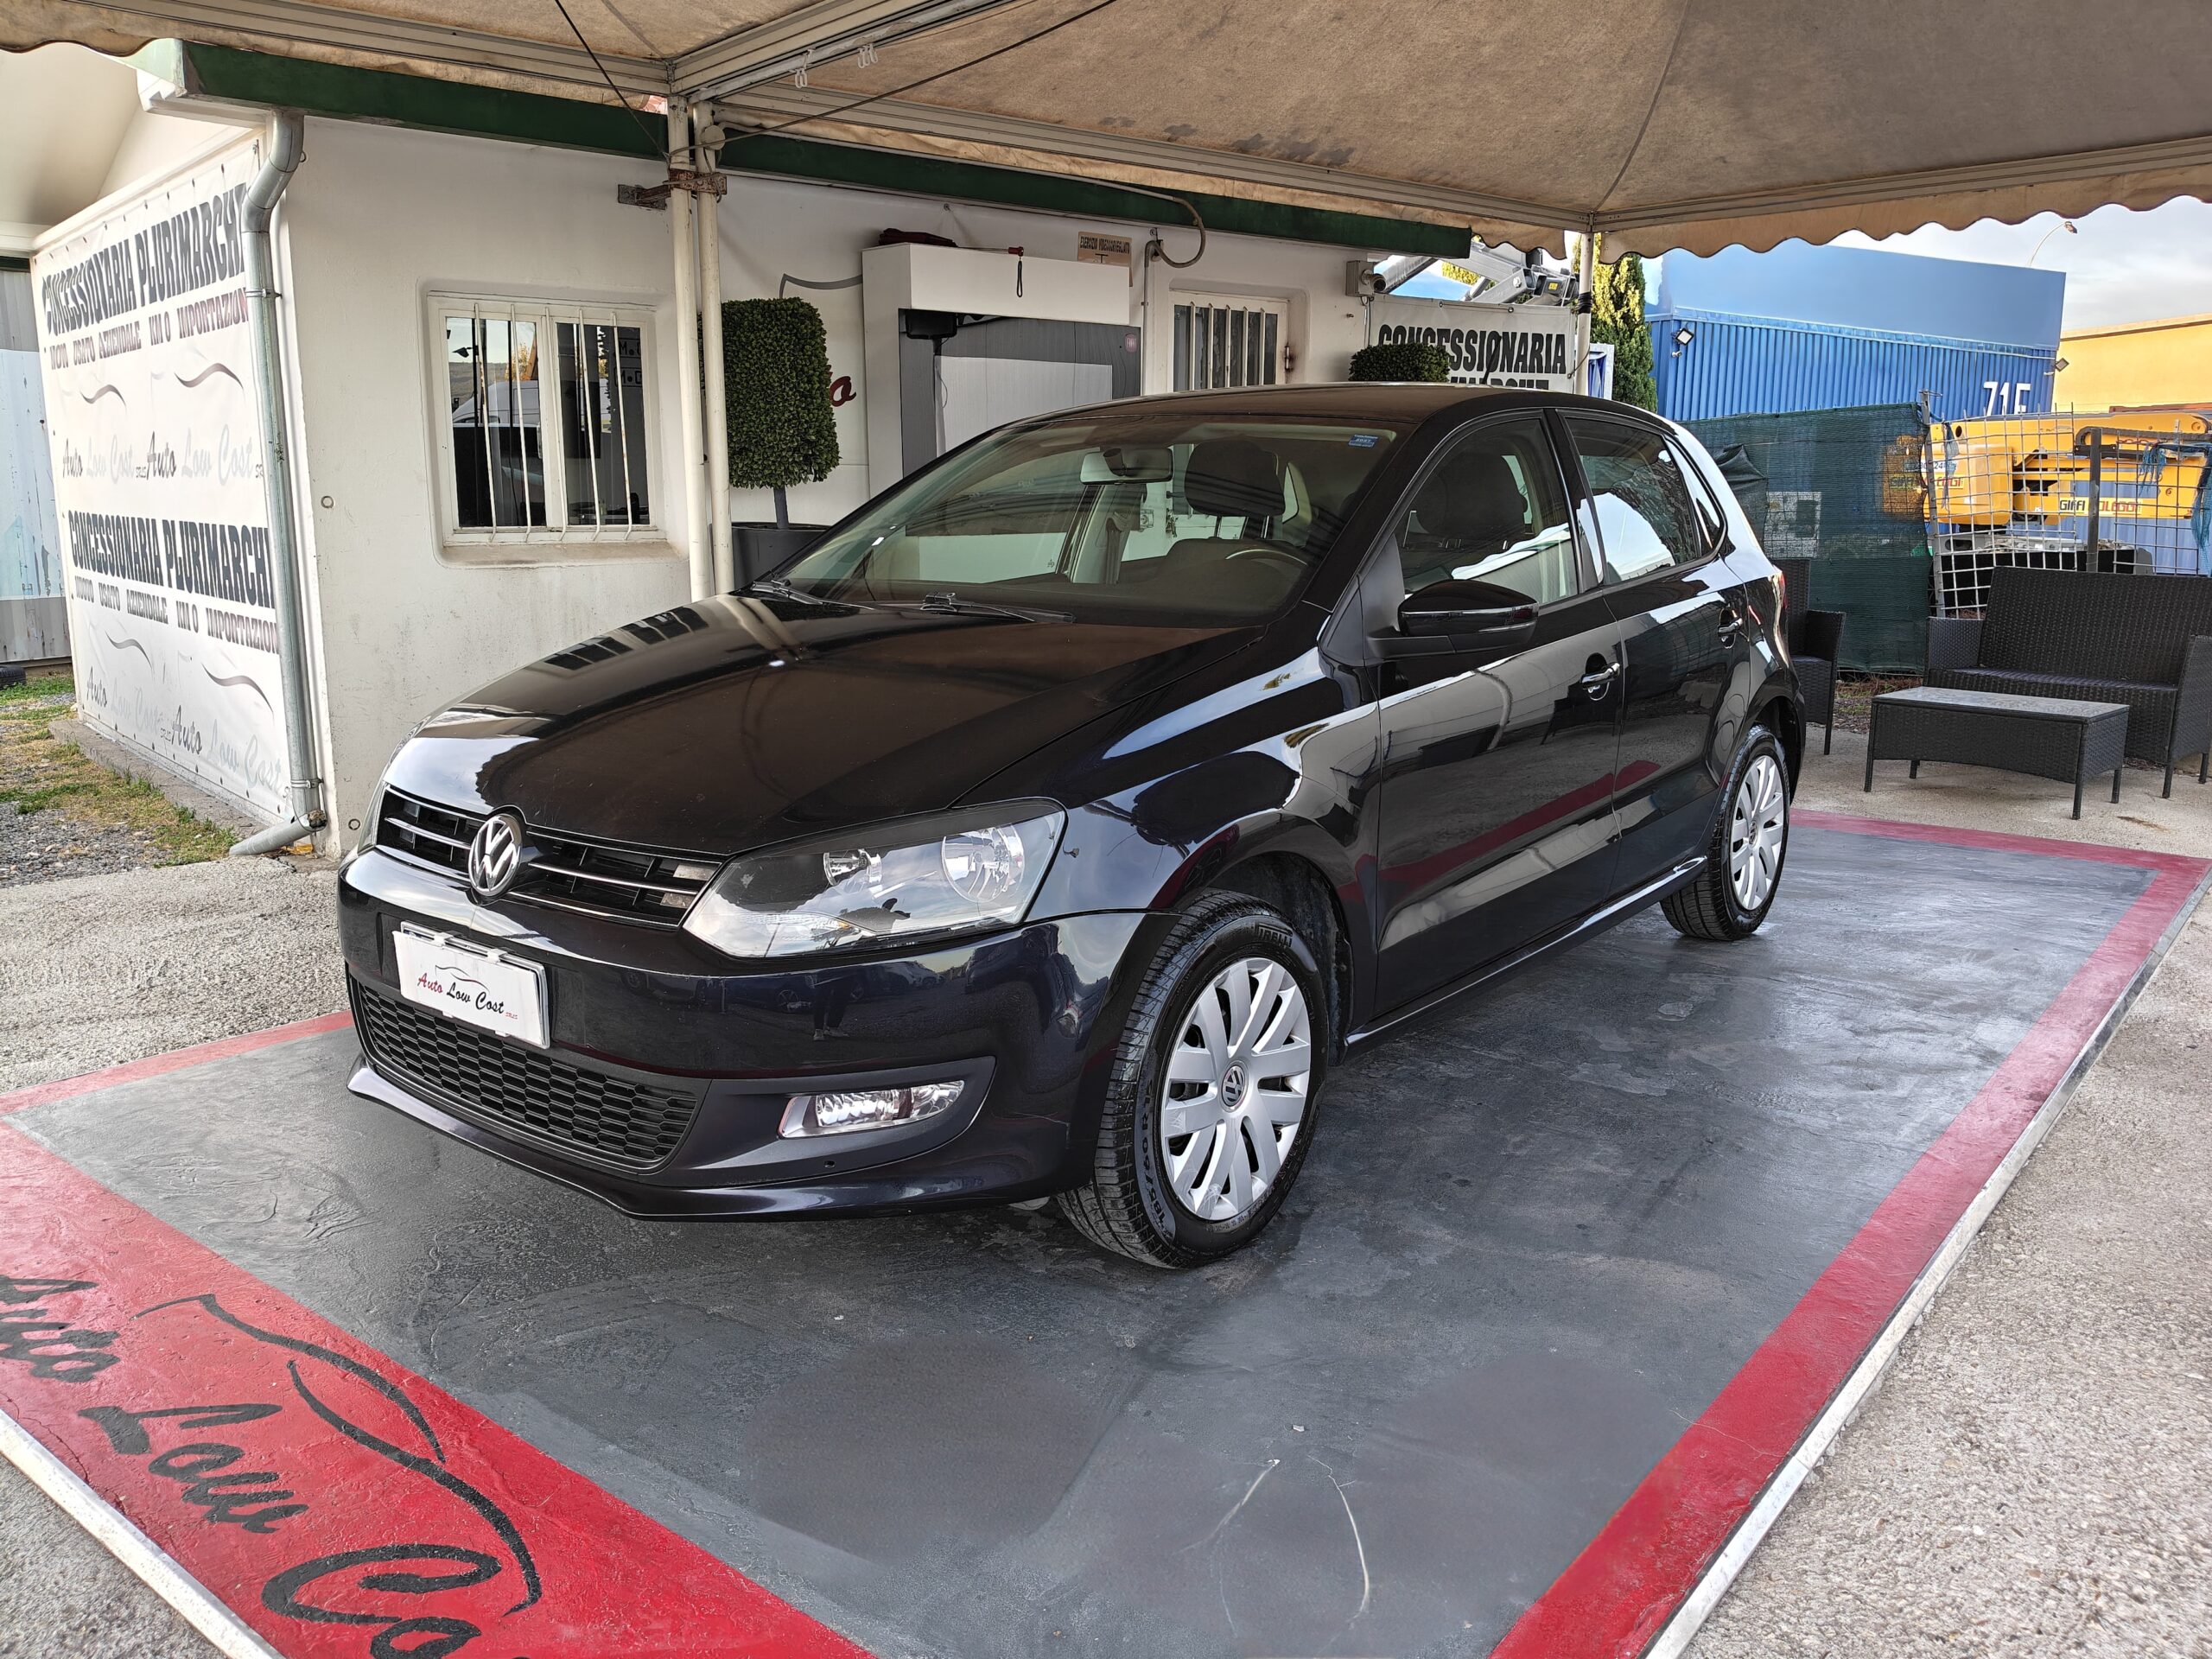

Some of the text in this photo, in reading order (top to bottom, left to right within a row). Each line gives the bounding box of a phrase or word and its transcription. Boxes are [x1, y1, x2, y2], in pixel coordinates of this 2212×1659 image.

[99, 321, 142, 359] AZIENDALE
[149, 314, 163, 346] KM
[176, 287, 249, 339] IMPORTAZION
[62, 438, 83, 479] Auto
[146, 431, 176, 480] Auto
[182, 428, 213, 479] Low
[218, 423, 255, 486] Cost
[2060, 499, 2086, 511] GIFFI
[2088, 500, 2138, 512] OLEGGI
[68, 510, 164, 587] CONCESSIONARIA
[99, 582, 121, 611] USATO
[126, 589, 168, 625] AZIENDALE
[176, 601, 191, 631] KM
[206, 607, 280, 655] IMPORTAZION
[86, 666, 107, 708] Auto
[171, 705, 203, 755] Auto
[418, 972, 443, 994] Auto
[446, 982, 471, 1003] Low
[475, 991, 505, 1014] Cost
[79, 1402, 309, 1534] Low
[261, 1543, 502, 1659] Co
